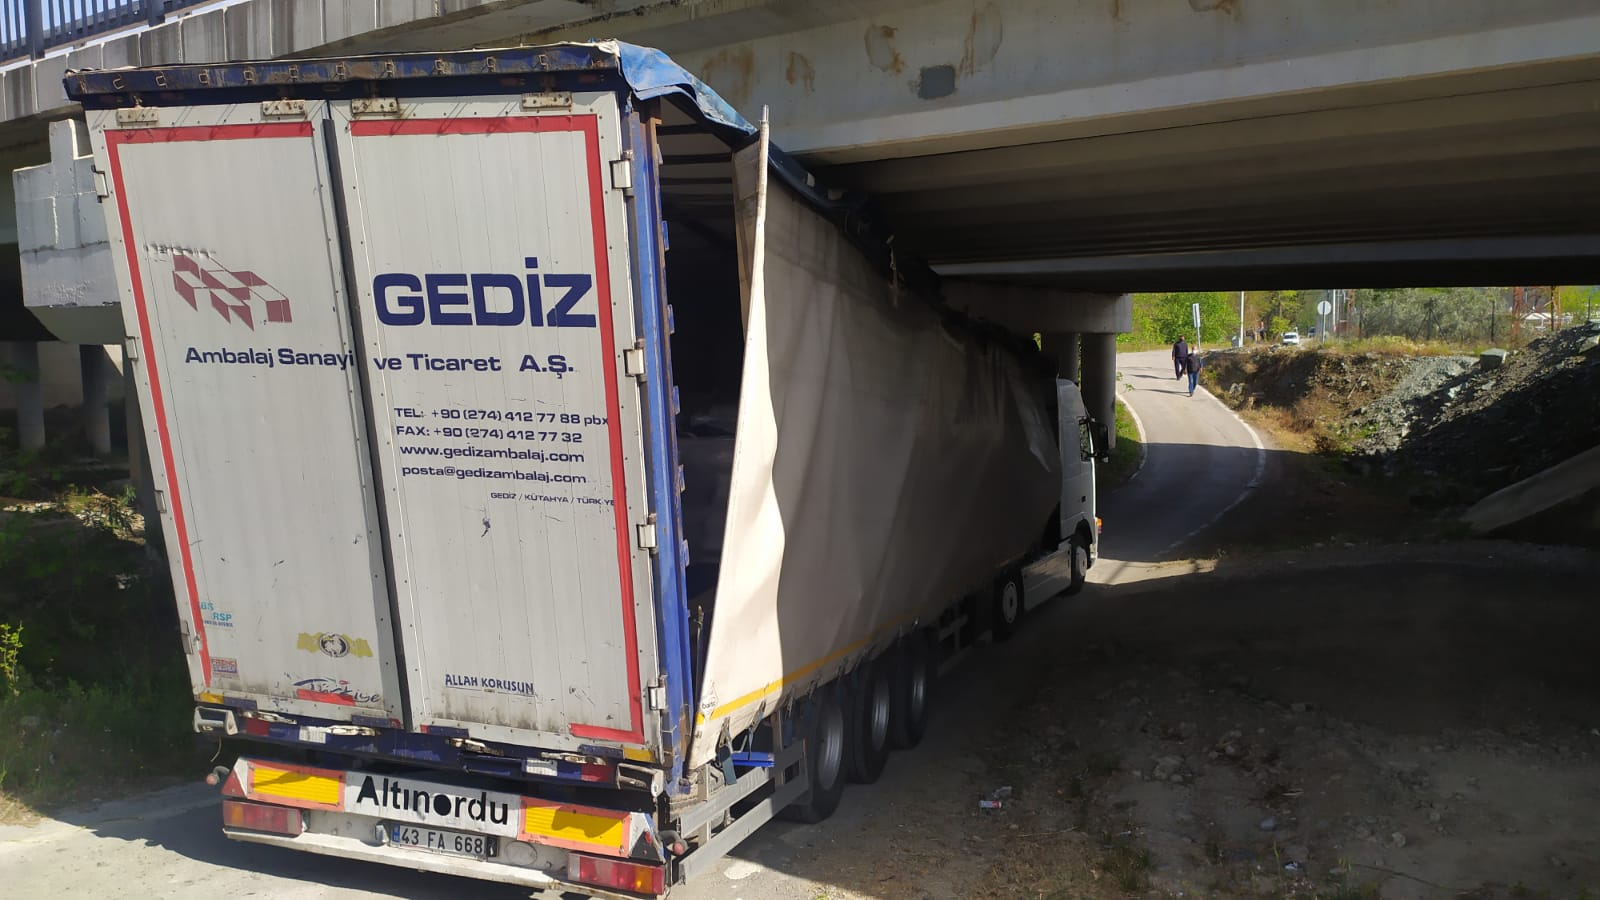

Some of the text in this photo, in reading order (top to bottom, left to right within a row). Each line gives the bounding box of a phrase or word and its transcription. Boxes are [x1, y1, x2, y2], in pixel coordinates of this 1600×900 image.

[373, 257, 596, 327] GEDİZ
[185, 347, 574, 379] Ambalaj Sanayi ve Ticaret A.Ş.
[394, 408, 608, 427] TEL: +90 (274) 412 77 88 pbx
[396, 426, 582, 443] FAX: +90 (274) 412 77 32
[400, 446, 584, 463] www.gedizambalaj.com
[402, 466, 586, 483] posta@gedizambalaj.com
[524, 493, 569, 503] KÜTAHYA
[576, 497, 615, 506] TÜRKYE
[445, 674, 535, 695] ALLAH KORUSUN
[357, 776, 508, 825] Altınordu
[402, 828, 419, 845] 43
[428, 832, 445, 849] FA
[455, 836, 483, 854] 668
